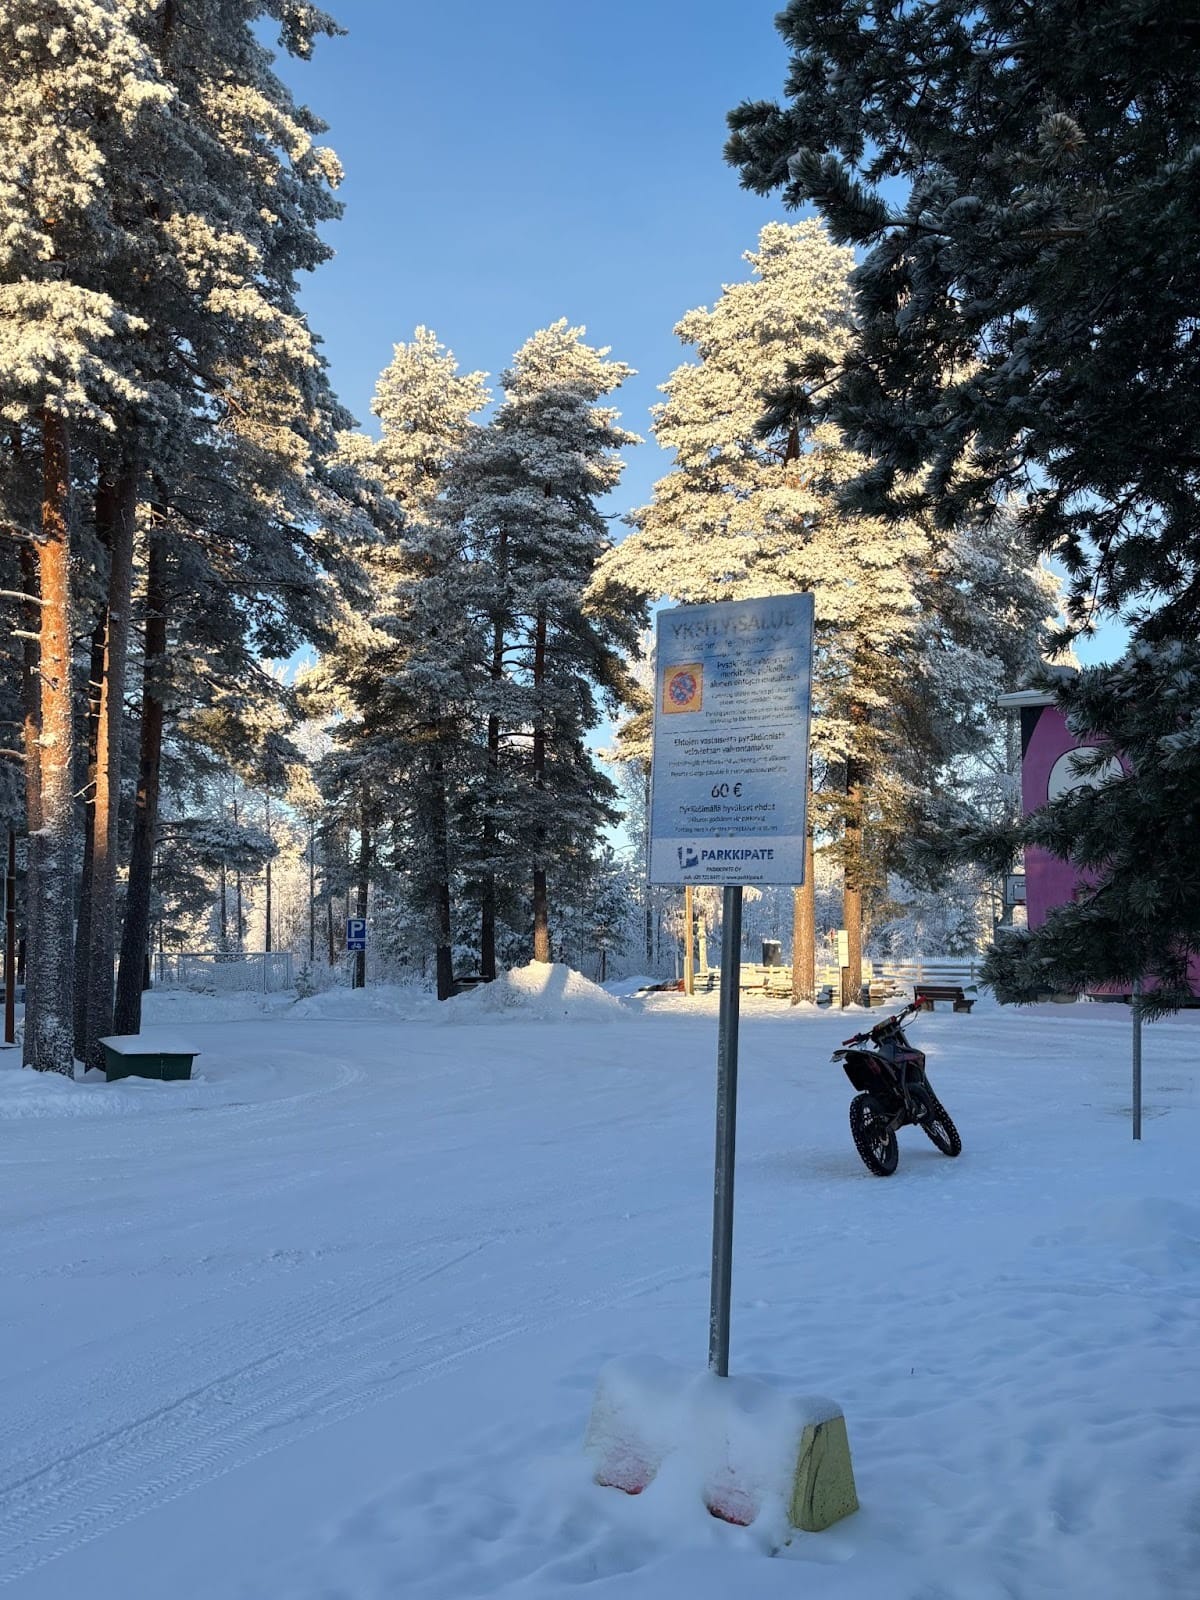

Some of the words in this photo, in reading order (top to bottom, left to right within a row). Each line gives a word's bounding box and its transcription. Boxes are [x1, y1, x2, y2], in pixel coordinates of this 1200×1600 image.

[711, 783, 729, 798] 60
[733, 782, 743, 798] €
[701, 848, 774, 861] PARKKIPATE
[350, 920, 364, 937] P
